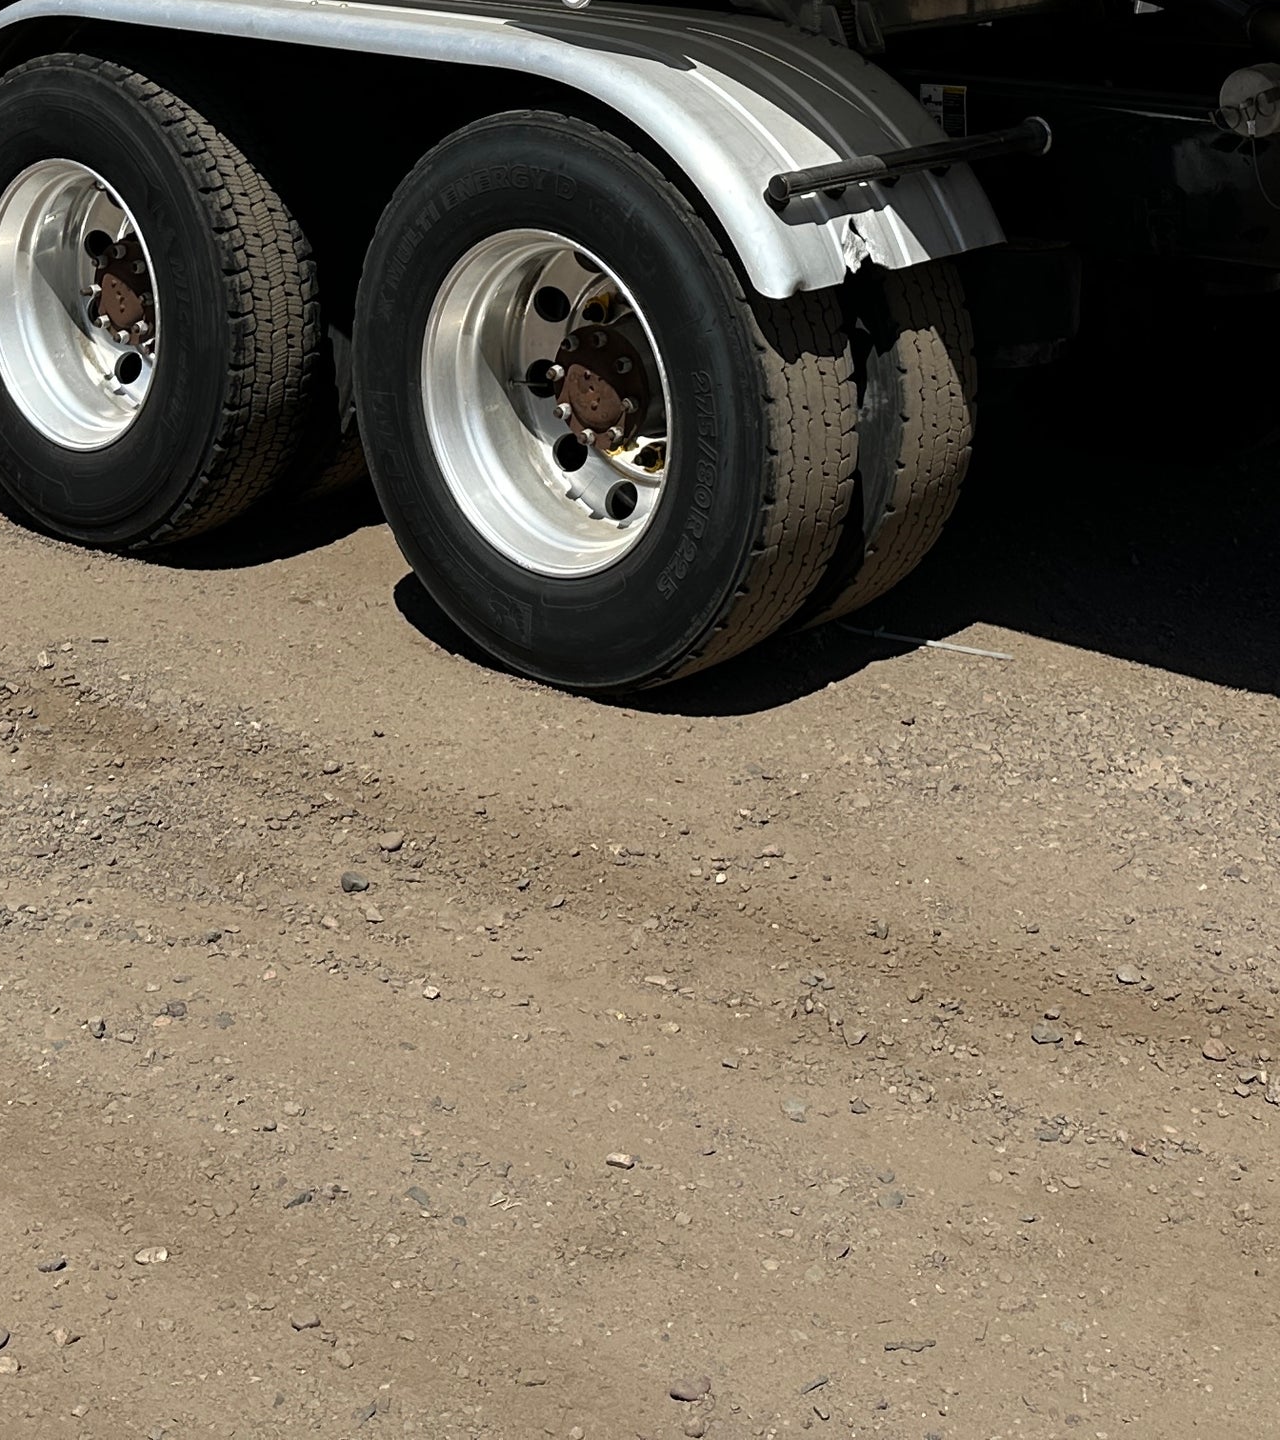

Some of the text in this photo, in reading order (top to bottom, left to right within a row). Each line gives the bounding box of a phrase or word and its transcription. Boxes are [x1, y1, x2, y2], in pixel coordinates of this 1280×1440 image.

[387, 199, 440, 290] MULTI
[439, 163, 547, 211] ENERGY
[554, 172, 578, 200] D
